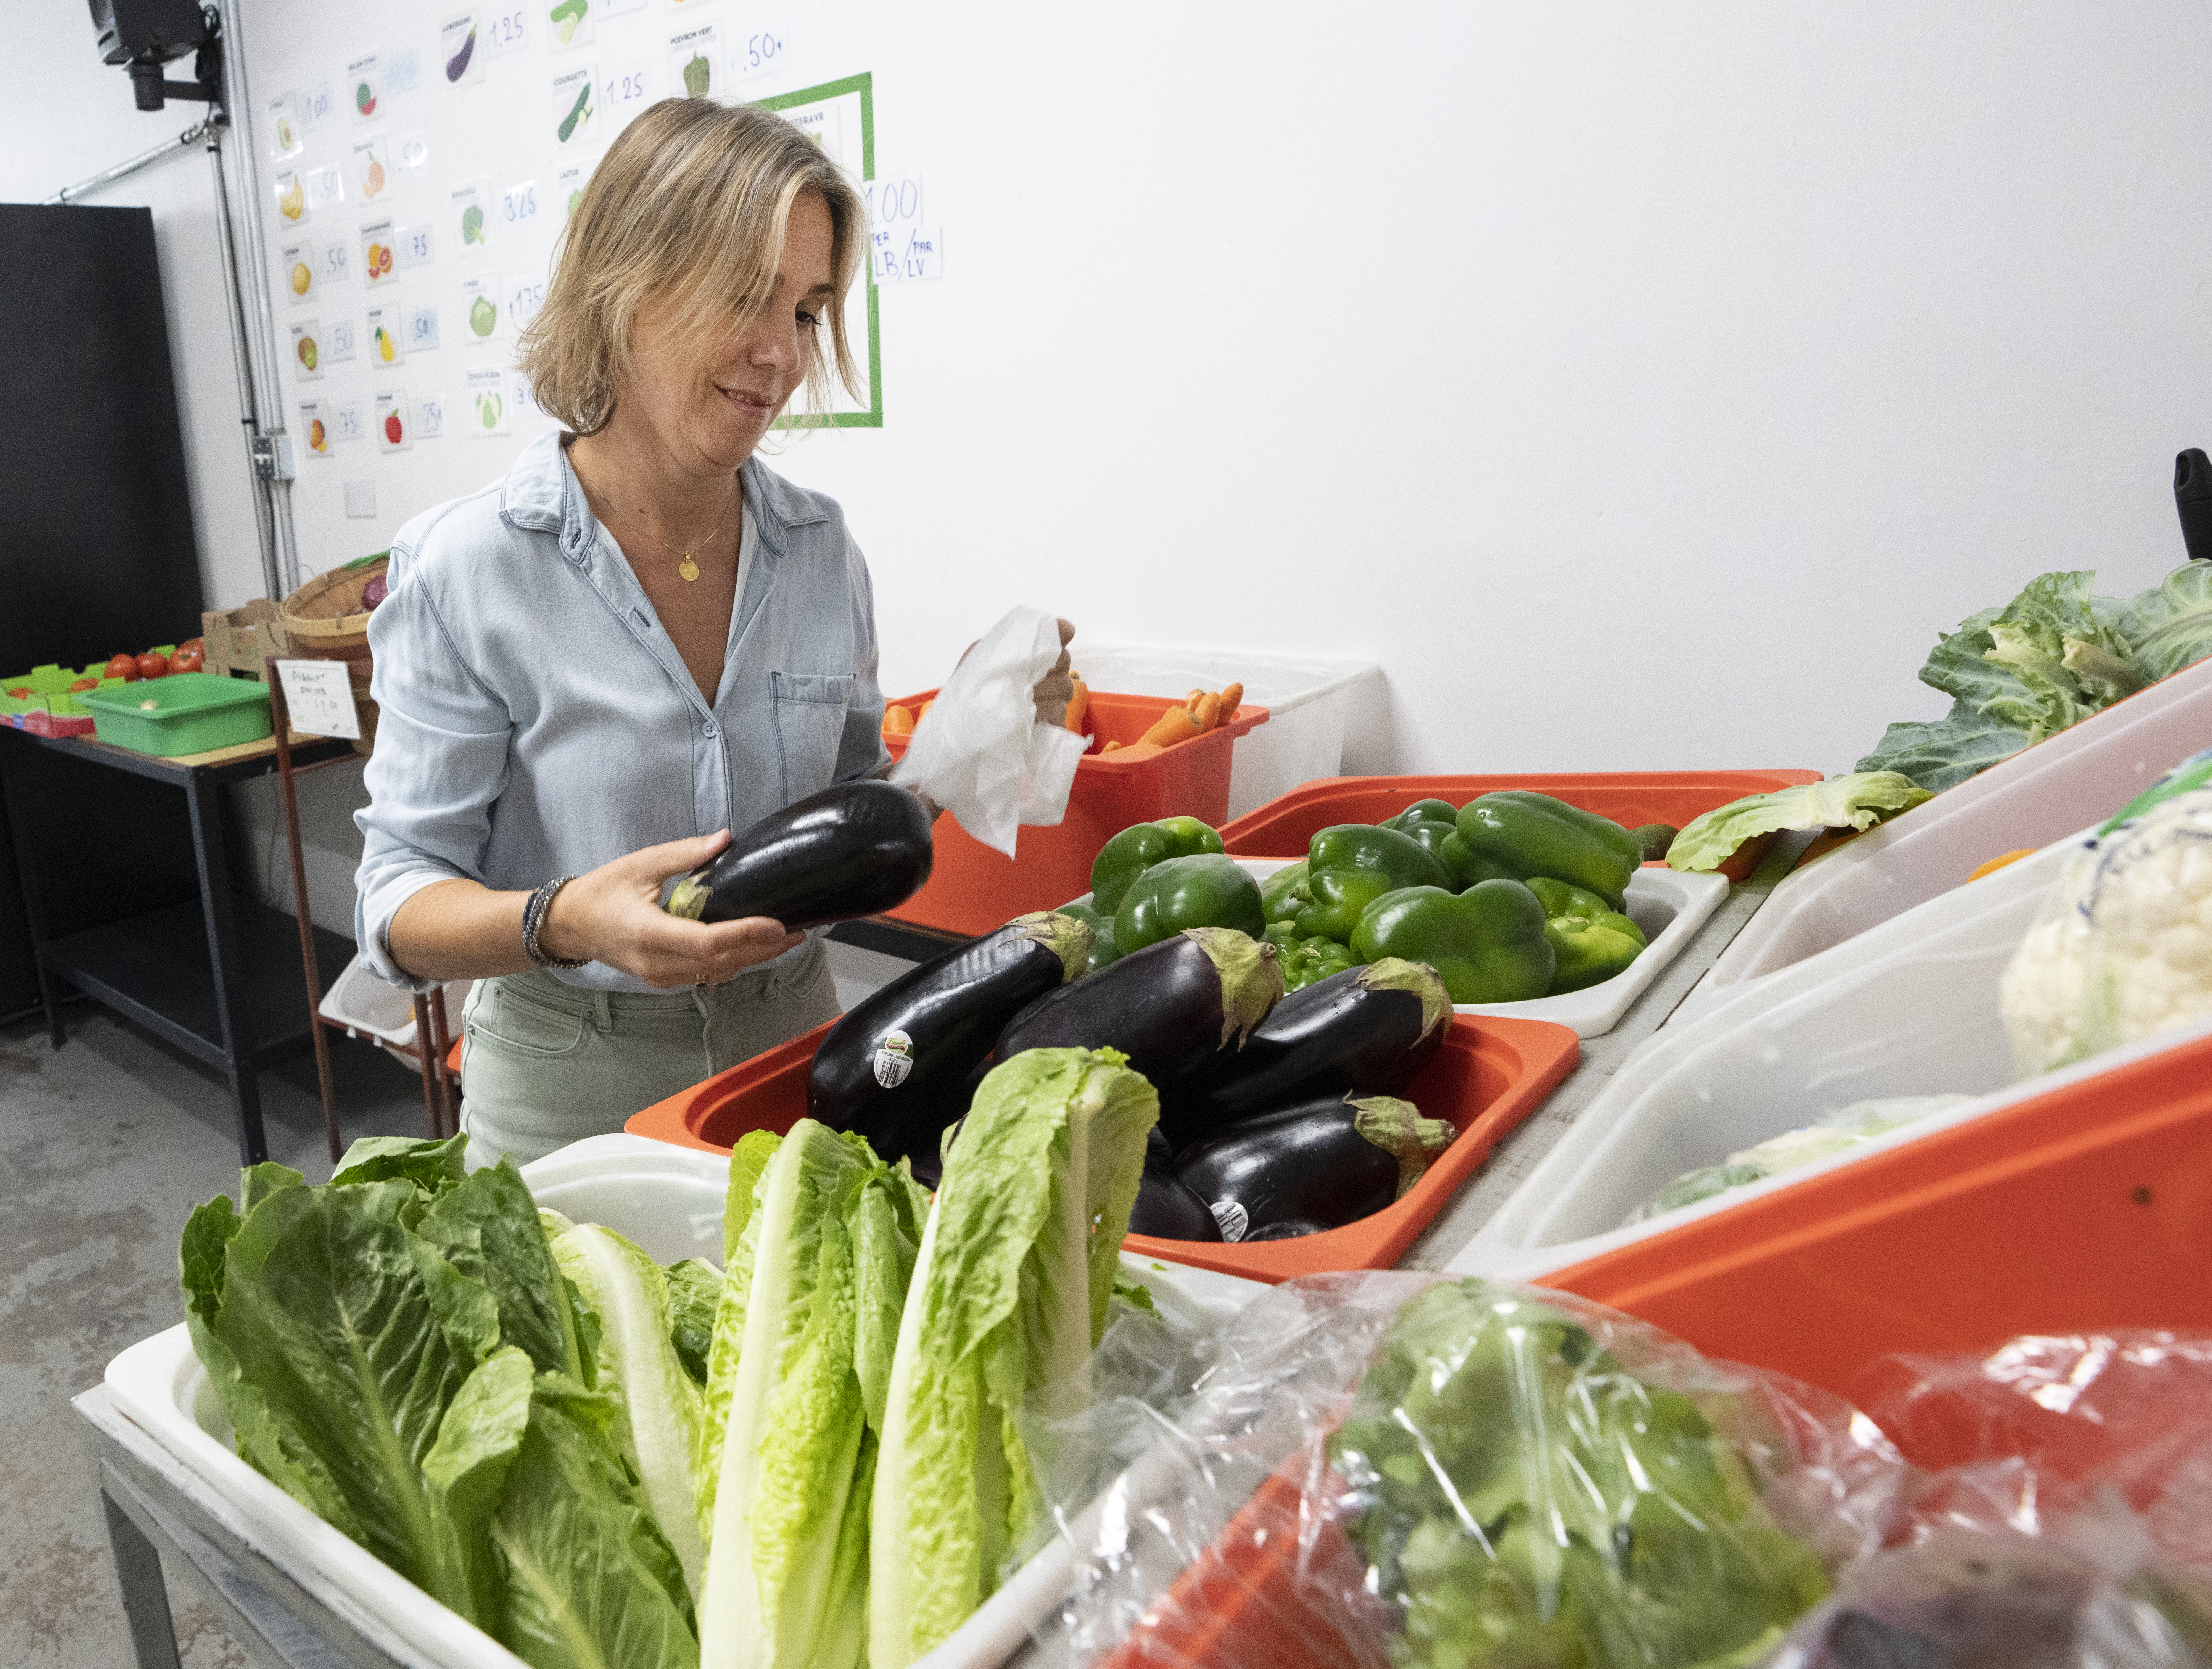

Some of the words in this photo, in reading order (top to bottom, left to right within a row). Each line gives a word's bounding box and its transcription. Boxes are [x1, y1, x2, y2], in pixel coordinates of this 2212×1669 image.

[490, 11, 523, 48] 1.25
[606, 72, 642, 105] 1.25
[913, 241, 934, 256] PAR
[908, 258, 924, 277] LV
